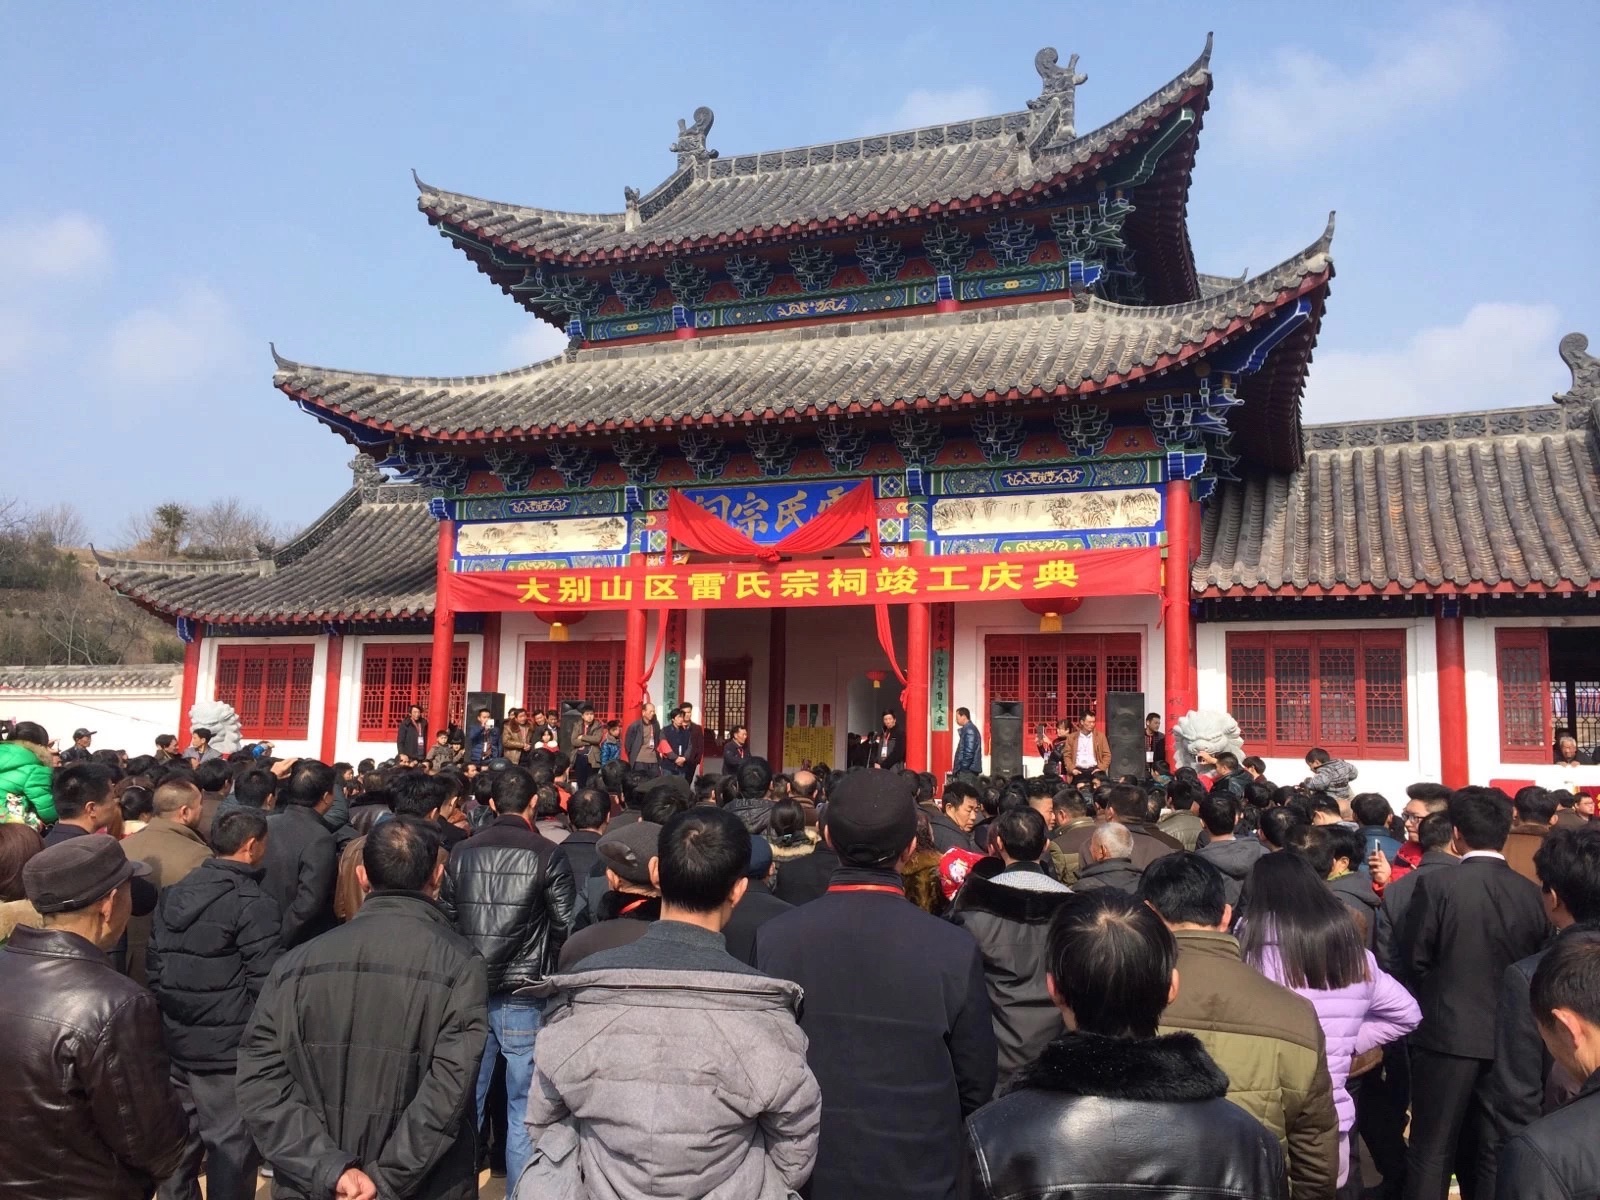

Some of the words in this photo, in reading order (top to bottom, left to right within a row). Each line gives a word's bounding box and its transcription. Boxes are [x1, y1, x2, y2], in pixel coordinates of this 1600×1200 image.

[516, 559, 1080, 605] 大别山区雷氏宗祠竣工庆典
